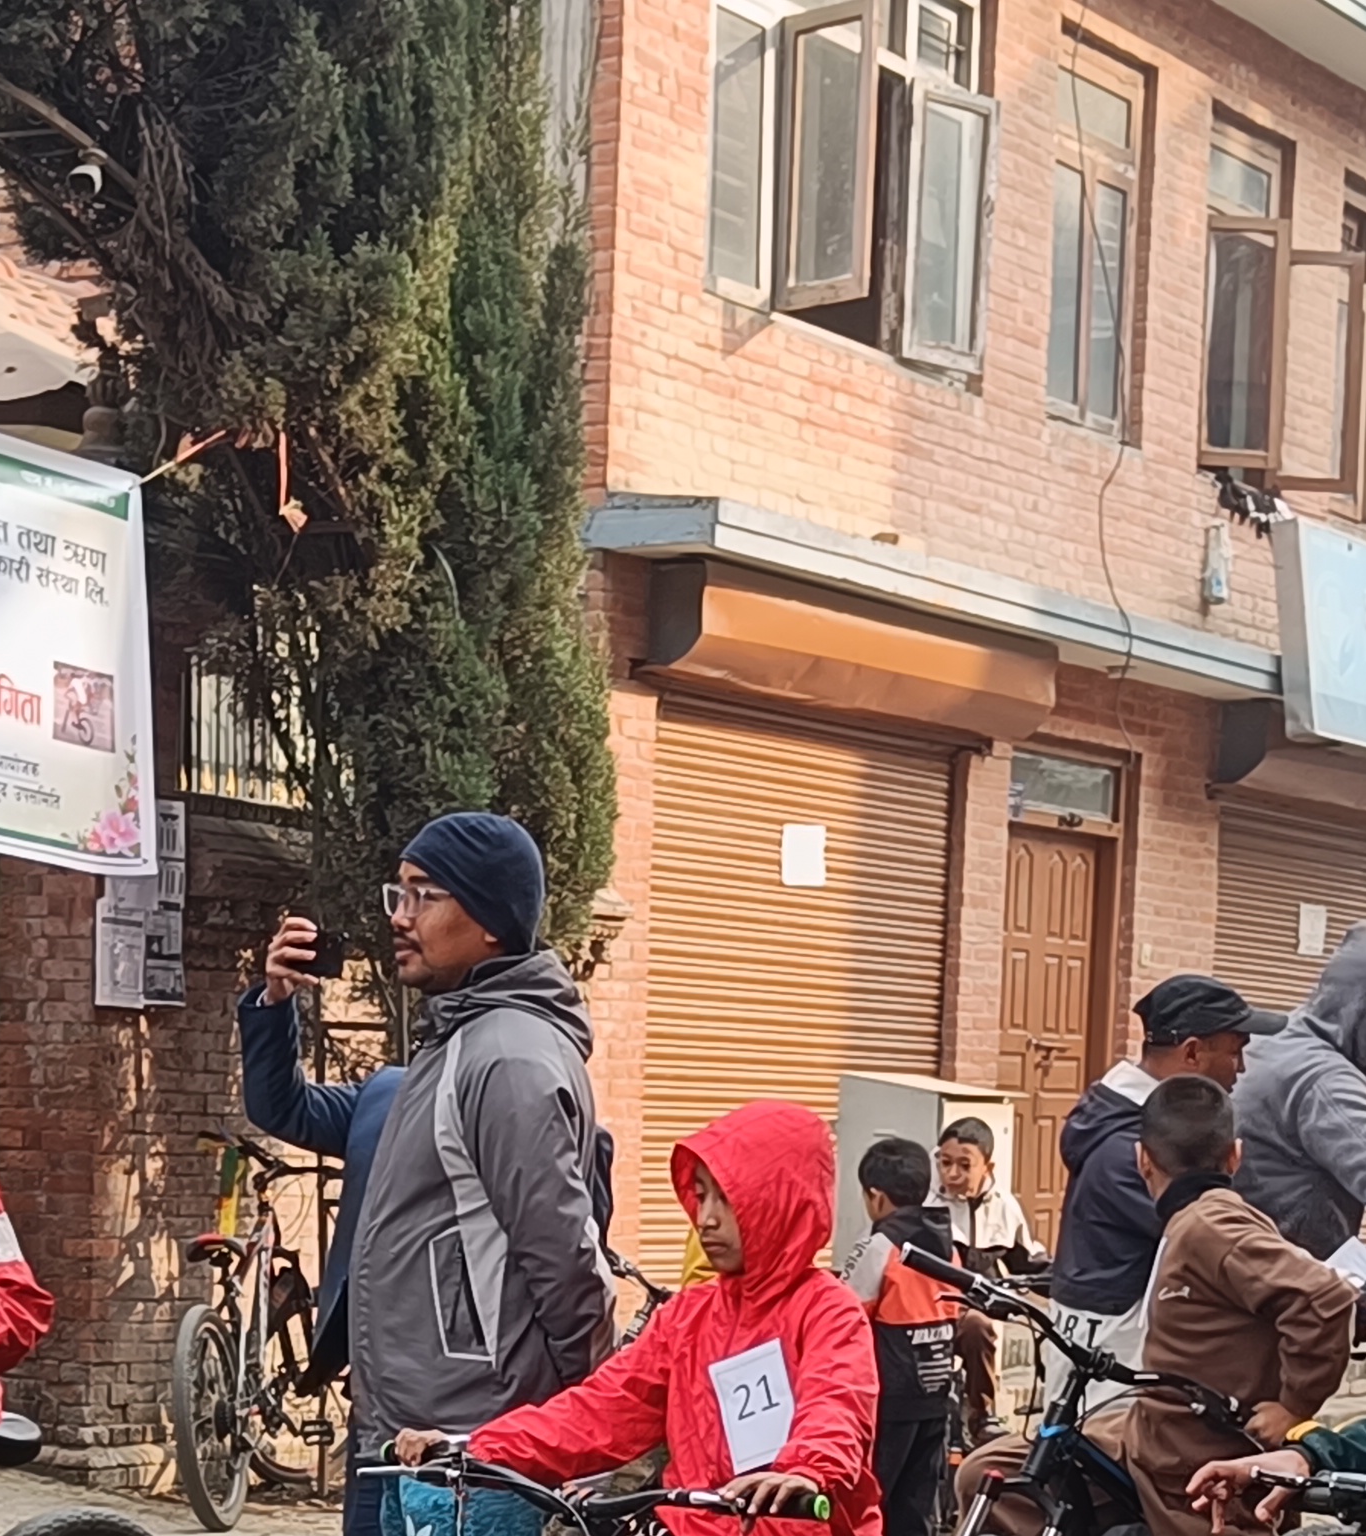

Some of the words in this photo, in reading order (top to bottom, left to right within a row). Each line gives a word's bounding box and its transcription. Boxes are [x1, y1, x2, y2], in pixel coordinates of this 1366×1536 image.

[16, 523, 57, 558] तथा
[63, 539, 107, 576] ऋण
[36, 565, 80, 597] संस्था
[733, 1374, 780, 1421] 21
